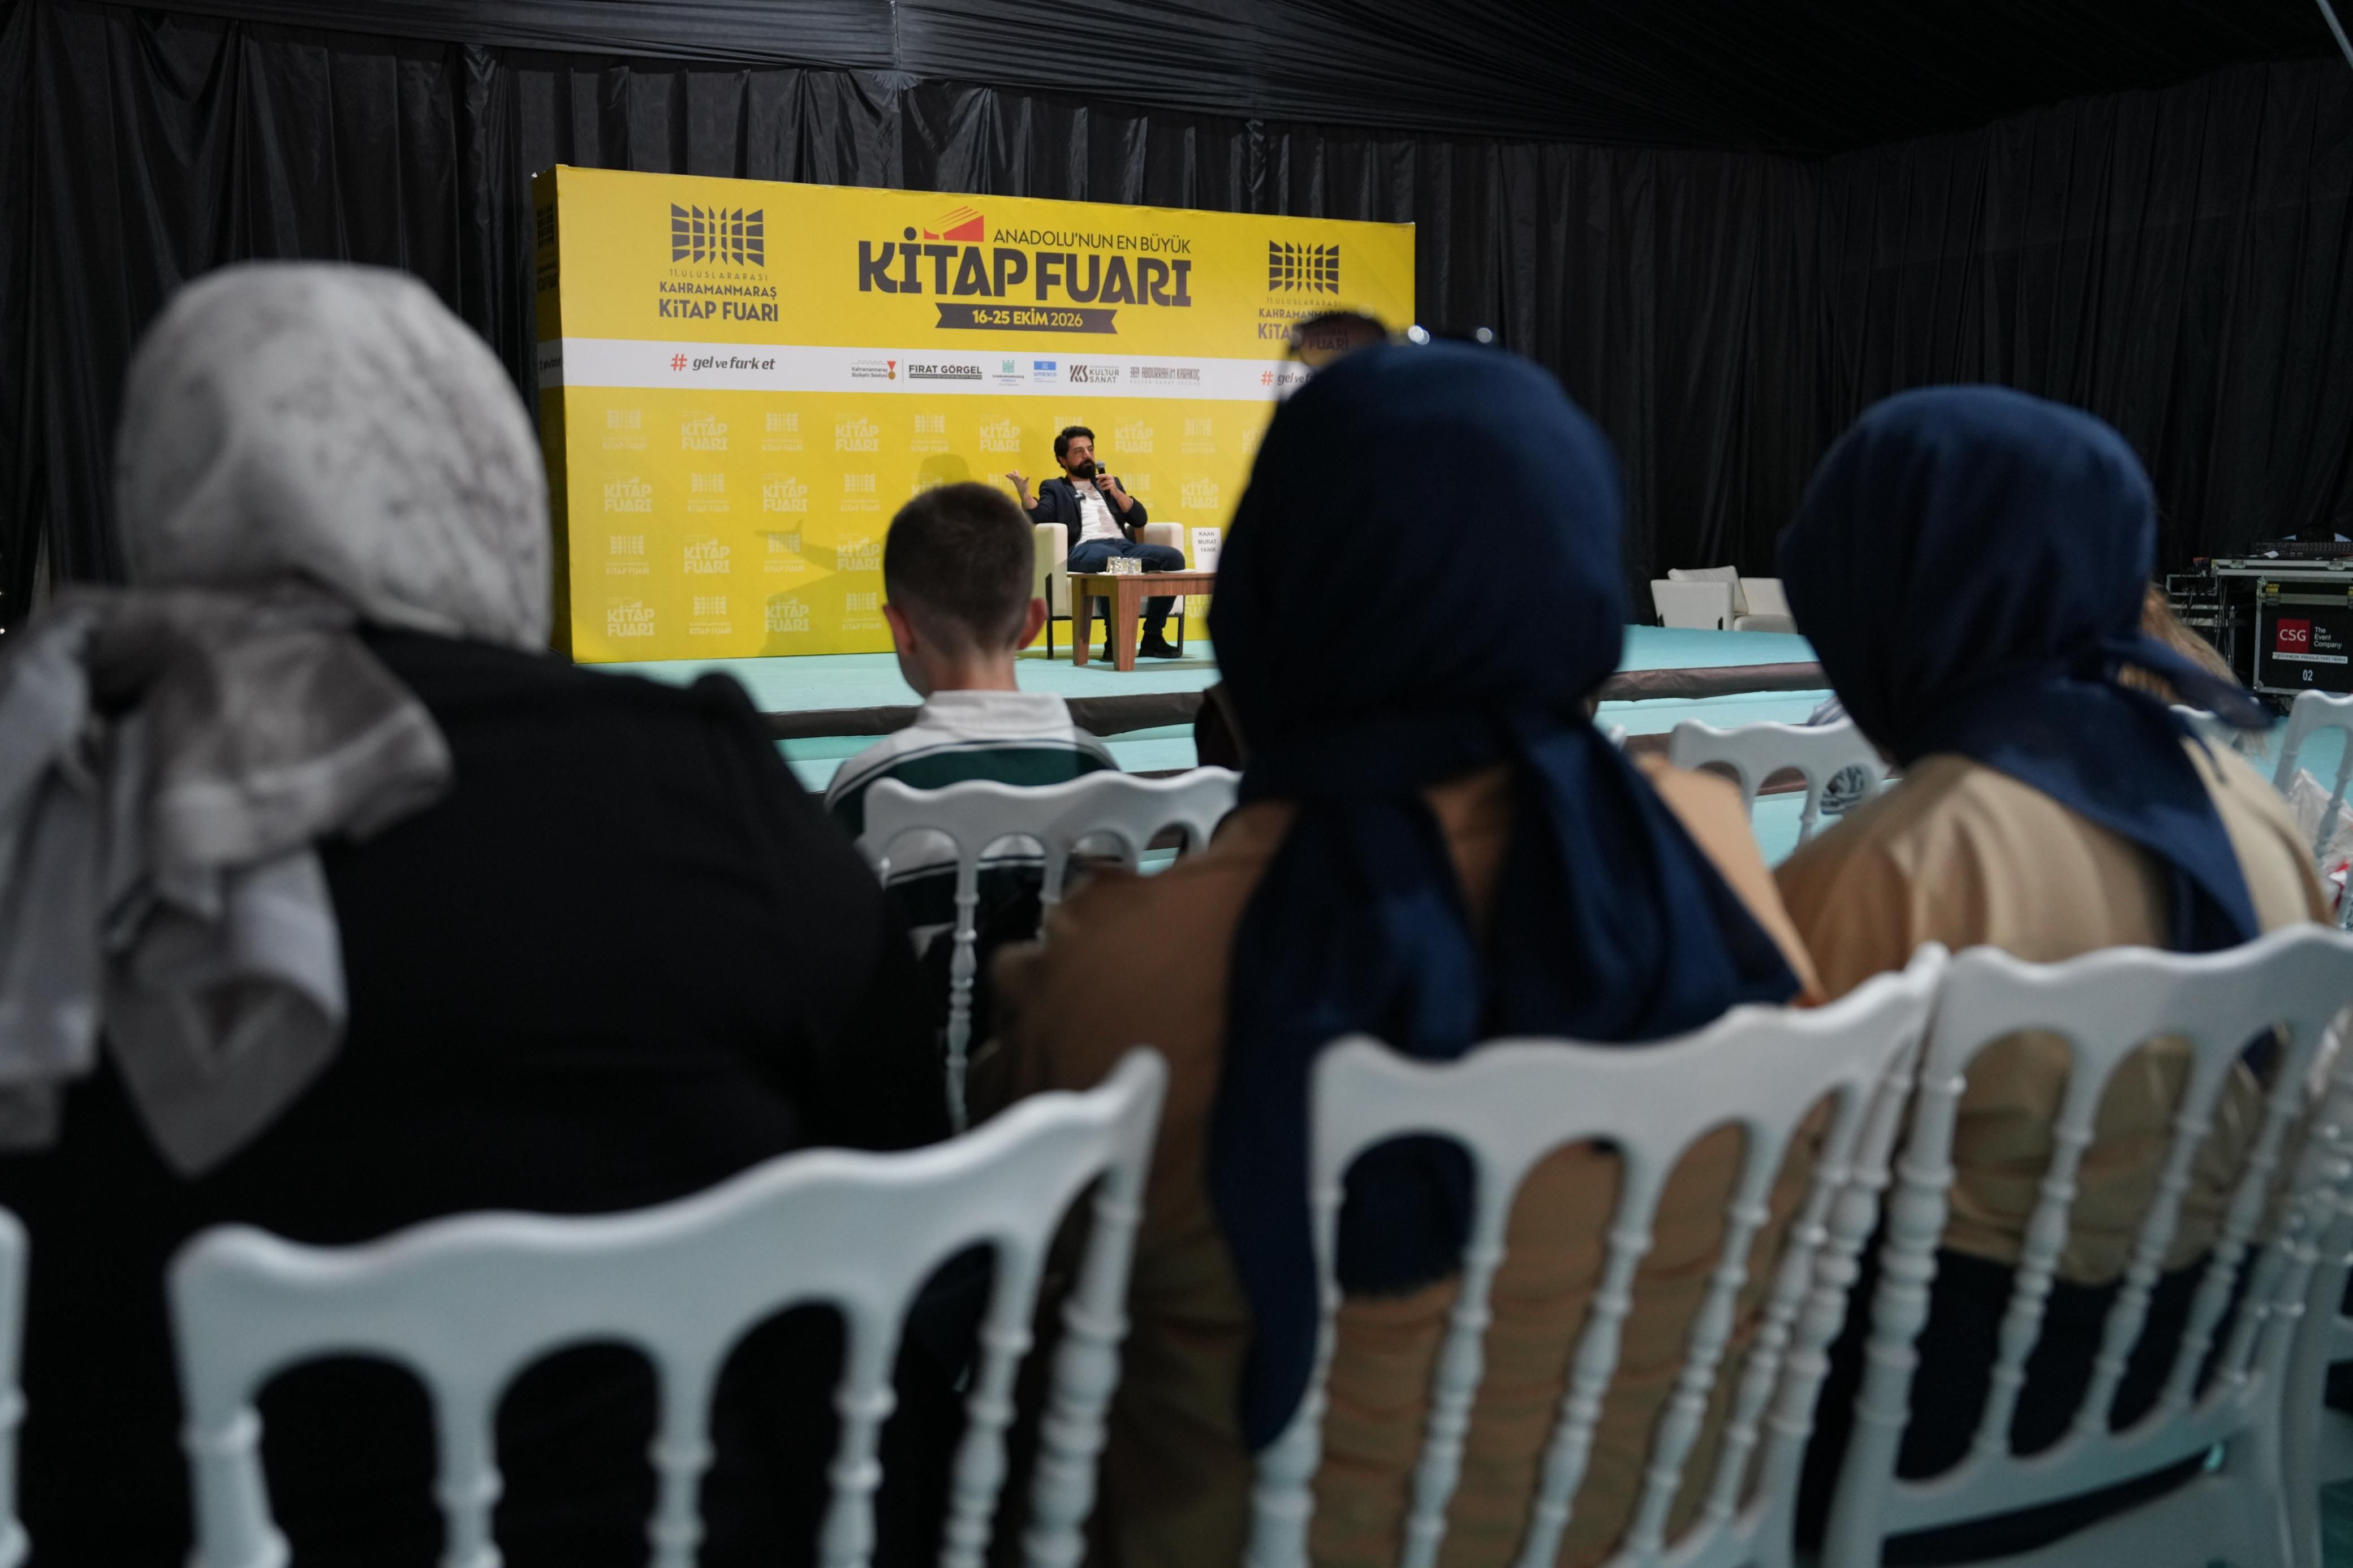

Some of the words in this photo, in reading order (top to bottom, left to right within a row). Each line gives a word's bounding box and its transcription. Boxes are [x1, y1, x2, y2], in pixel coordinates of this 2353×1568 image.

[993, 228, 1113, 248] ANADOLU'NUN
[1118, 235, 1137, 250] EN
[1140, 234, 1191, 254] BÜYÜK
[859, 226, 1028, 297] KİTAP
[1035, 252, 1191, 307] FUARI
[660, 281, 777, 300] KAHRAMANMARAŞ
[722, 301, 779, 322] FUARI
[972, 309, 1011, 325] 16-25
[1013, 308, 1049, 326] EKİM
[1050, 312, 1083, 327] 2026
[716, 360, 727, 369] ve
[730, 356, 760, 369] fark
[761, 358, 776, 370] et
[909, 365, 938, 373] FIRAT
[941, 365, 982, 374] GÖRGEL
[2279, 629, 2306, 642] CSG
[2313, 641, 2342, 650] Company
[2303, 669, 2313, 681] 02
